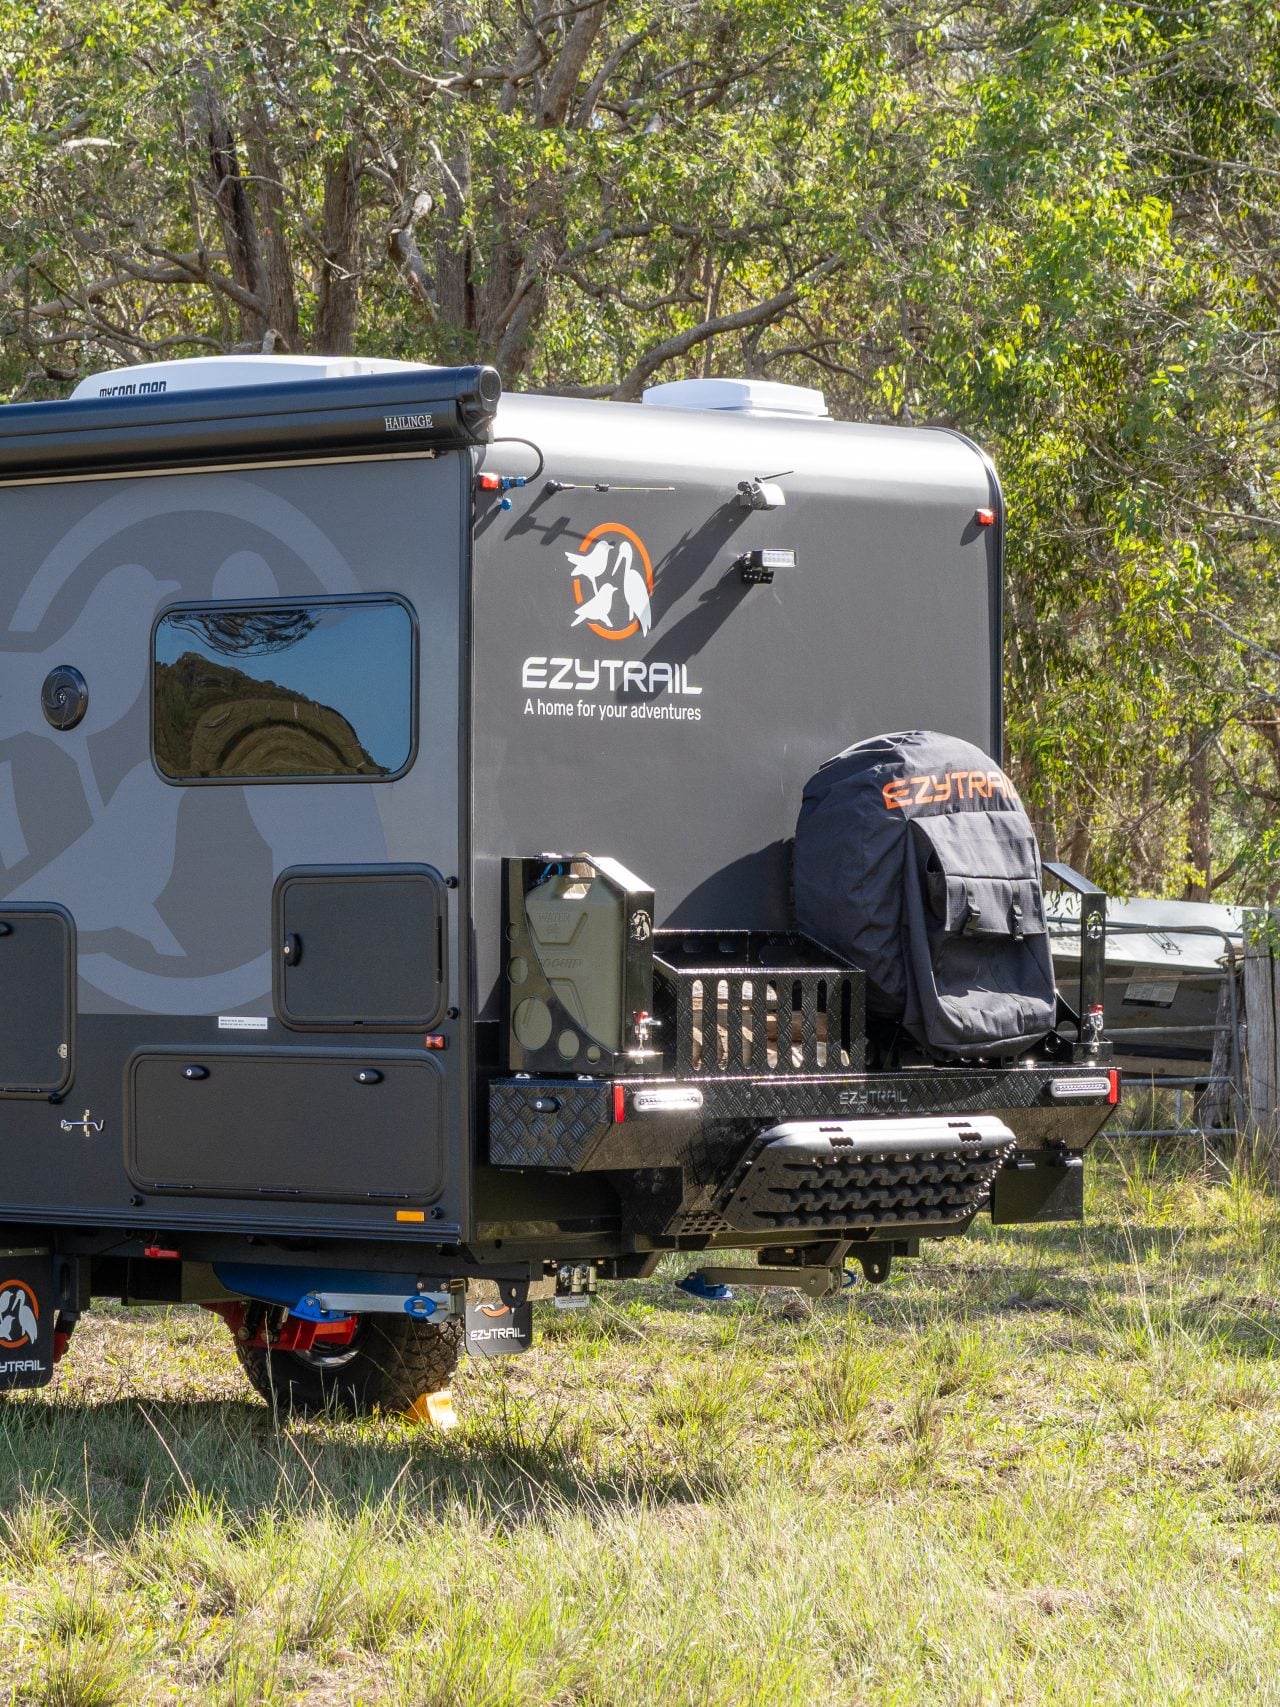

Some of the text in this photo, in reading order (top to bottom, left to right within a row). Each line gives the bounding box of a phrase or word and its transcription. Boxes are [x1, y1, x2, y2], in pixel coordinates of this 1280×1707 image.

[384, 414, 433, 429] HAILINGE
[522, 656, 703, 695] EZYTRAIL
[523, 698, 702, 721] A home for your adventures
[840, 1089, 908, 1105] EZYTRAIL
[470, 1327, 526, 1341] EZYTRAIL
